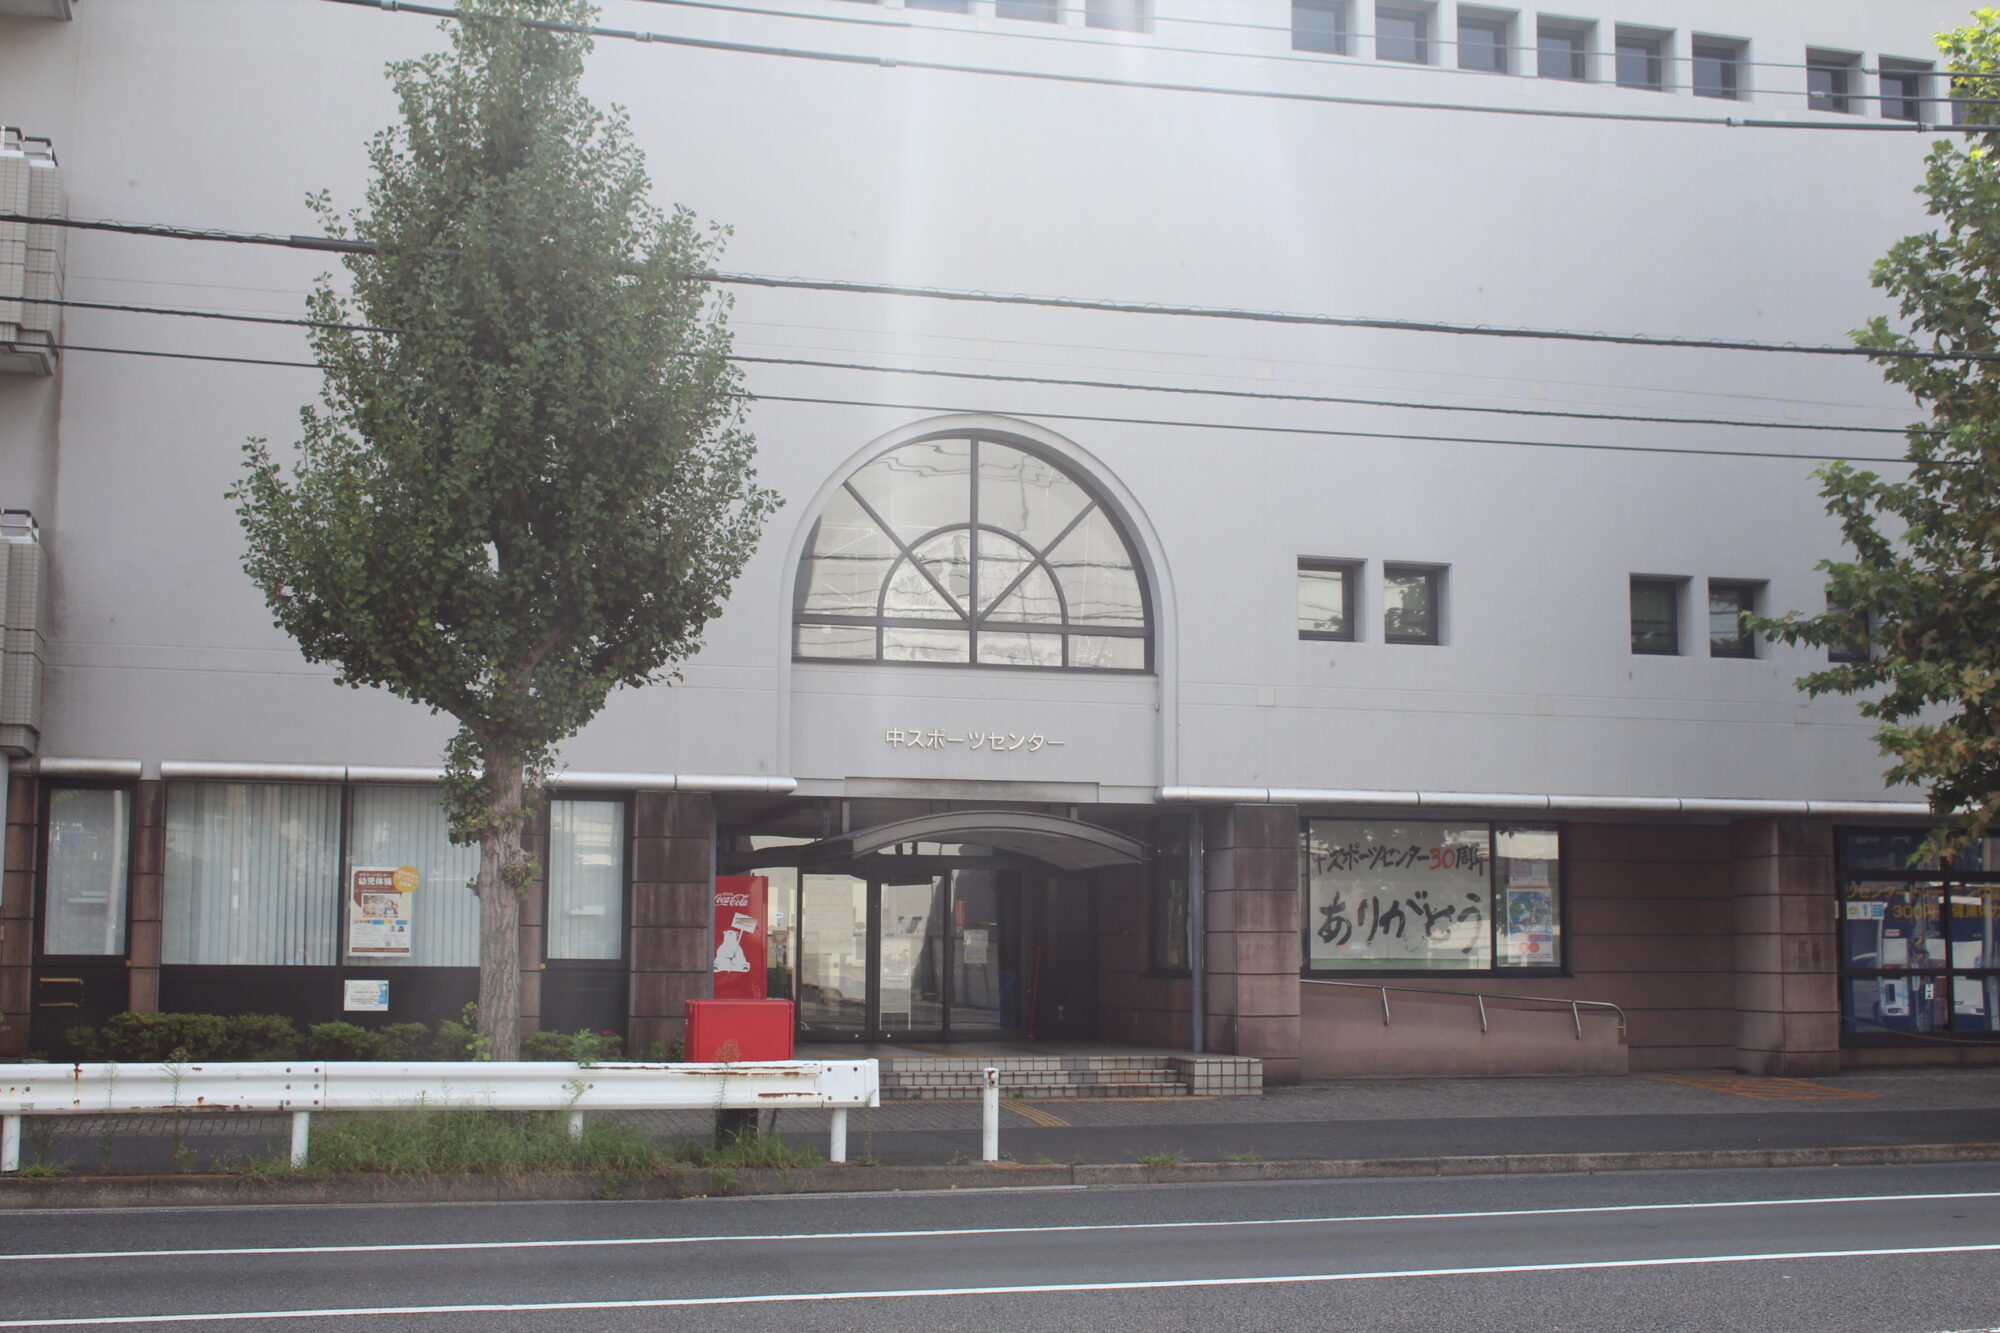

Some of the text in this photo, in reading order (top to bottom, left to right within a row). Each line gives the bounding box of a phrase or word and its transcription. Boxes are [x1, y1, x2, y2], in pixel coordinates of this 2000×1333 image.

[885, 727, 1065, 752] 中スポーツセンター
[1317, 890, 1484, 954] ありがとう
